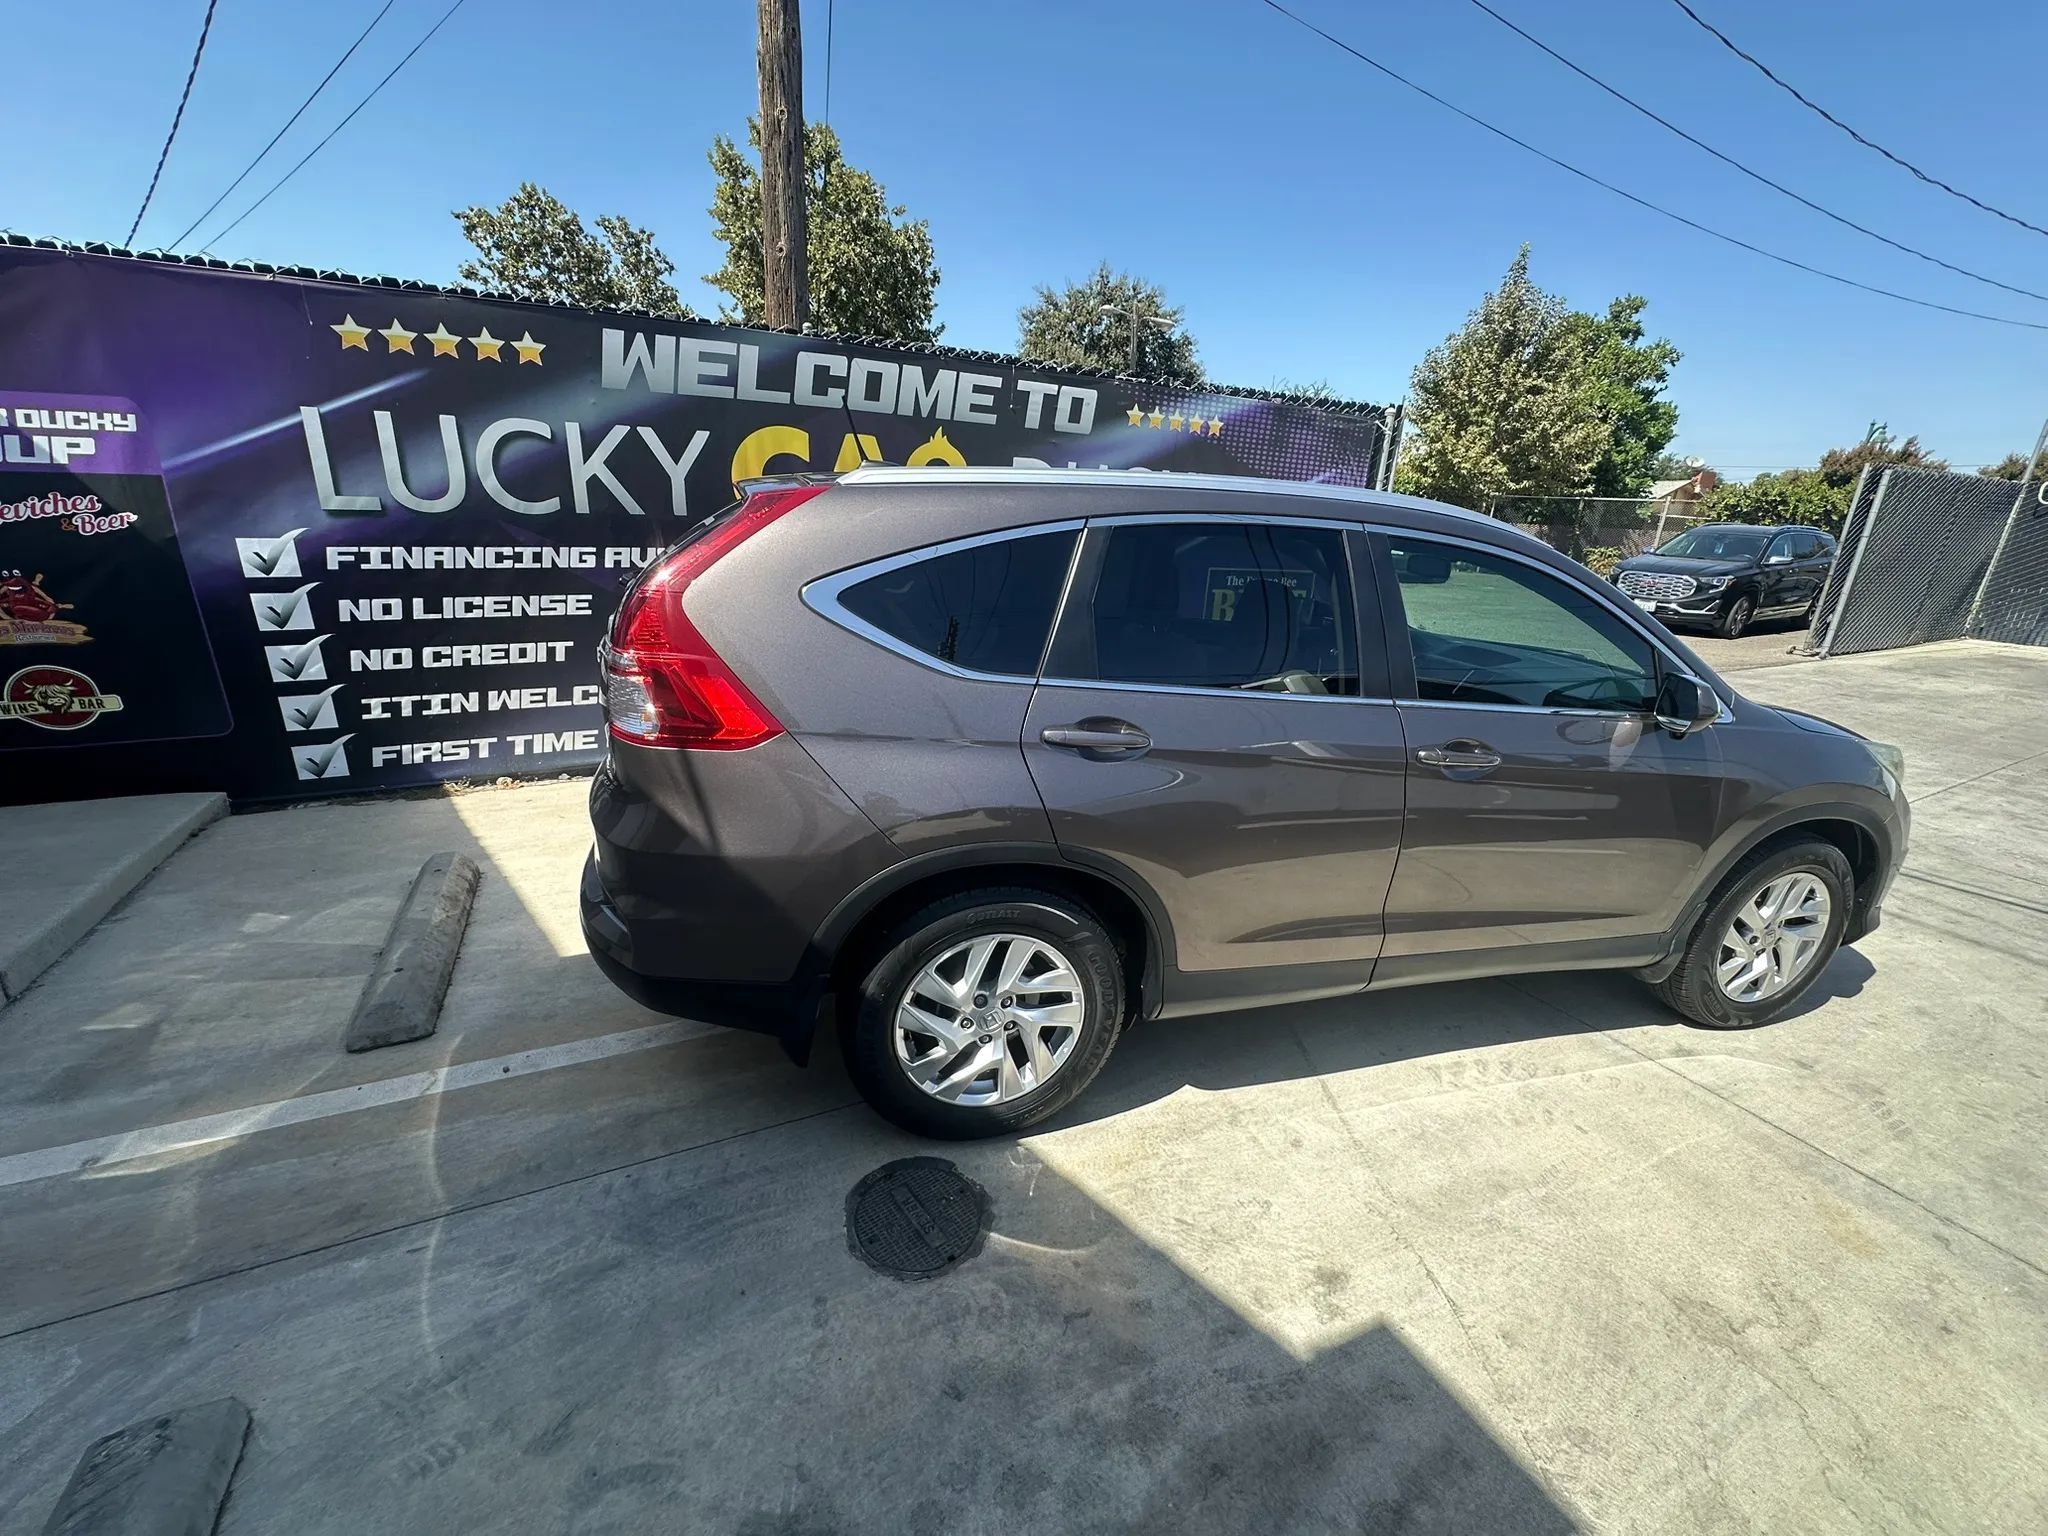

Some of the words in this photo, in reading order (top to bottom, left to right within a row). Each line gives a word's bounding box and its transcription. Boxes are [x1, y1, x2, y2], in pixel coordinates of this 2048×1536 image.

[601, 328, 1003, 426] WELCOME
[1015, 379, 1099, 435] TO
[15, 408, 138, 433] DUCKY
[0, 433, 96, 465] UP
[300, 406, 710, 516] LUCKY
[60, 517, 77, 531] &
[73, 512, 138, 536] Beer
[326, 546, 597, 570] FINANCING
[1225, 575, 1245, 586] The
[338, 597, 403, 622] NO
[412, 594, 594, 620] LICENSE
[350, 647, 413, 672] NO
[422, 641, 575, 668] CREDIT
[78, 697, 106, 710] BAR
[361, 691, 479, 720] ITIN
[372, 737, 498, 768] FIRST
[506, 729, 600, 755] TIME
